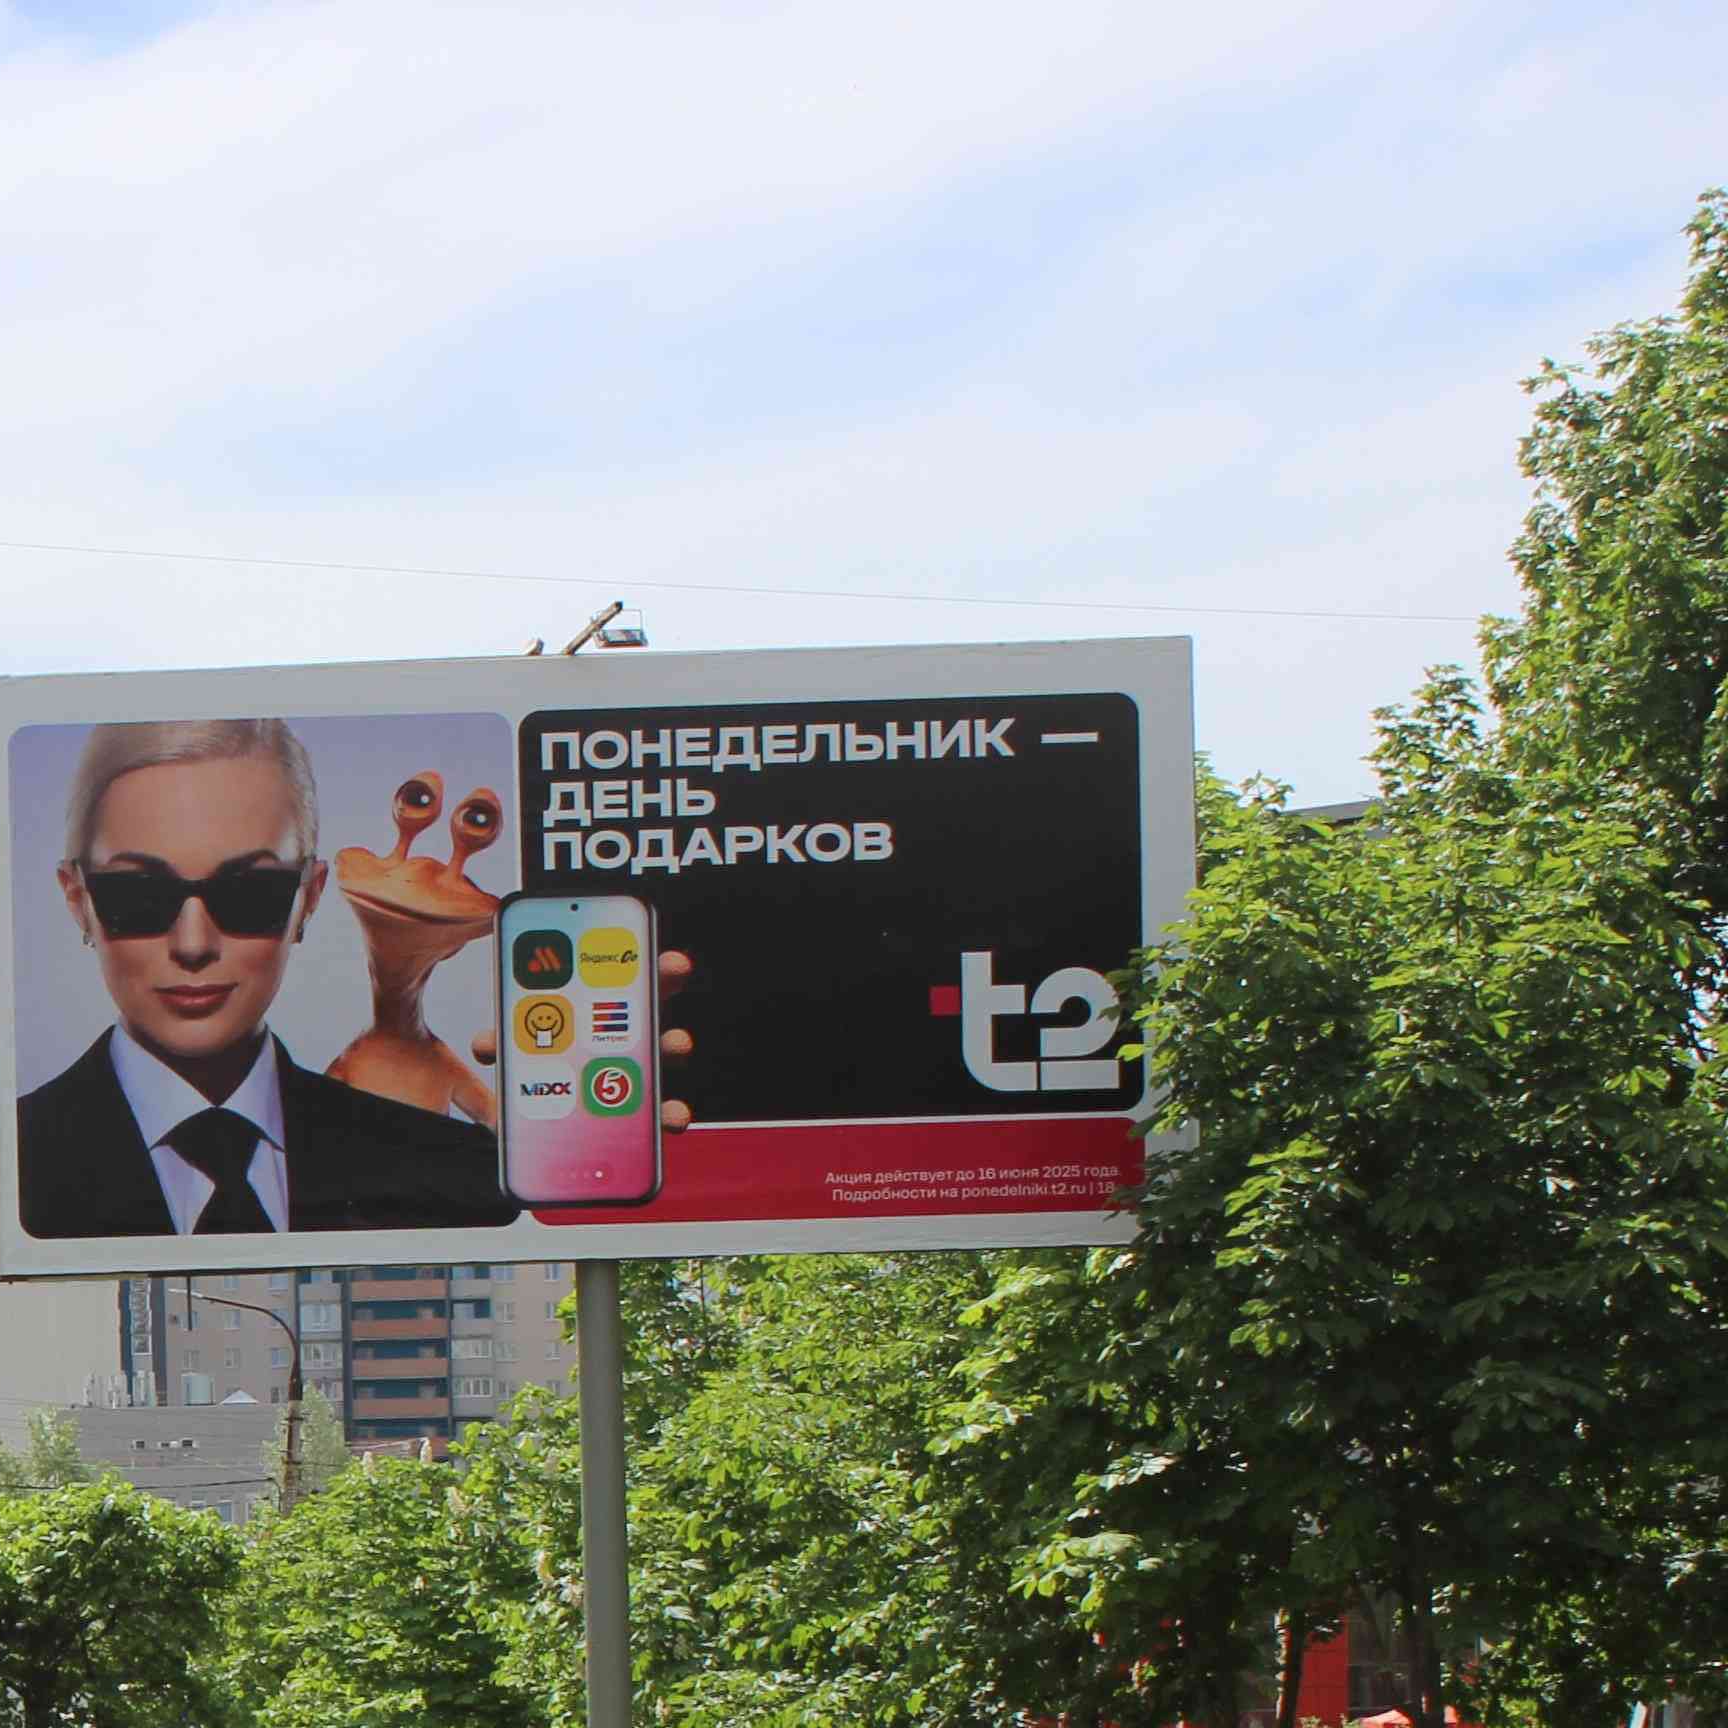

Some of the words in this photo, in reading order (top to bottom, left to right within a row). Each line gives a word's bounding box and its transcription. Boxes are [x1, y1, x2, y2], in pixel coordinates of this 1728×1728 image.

[540, 717, 1016, 773] ПОНЕДЕЛЬНИК
[543, 778, 717, 827] ДЕНЬ
[543, 822, 894, 875] ПОДАРКОВ
[960, 951, 1121, 1092] t2
[825, 1171, 872, 1185] Акция
[874, 1169, 953, 1184] действует
[955, 1169, 976, 1183] до
[999, 1168, 1040, 1179] июня
[1043, 1165, 1081, 1179] 2025
[832, 1186, 937, 1203] Подробности
[940, 1187, 959, 1198] на
[962, 1182, 1086, 1200] ponedelniki.t2.ru
